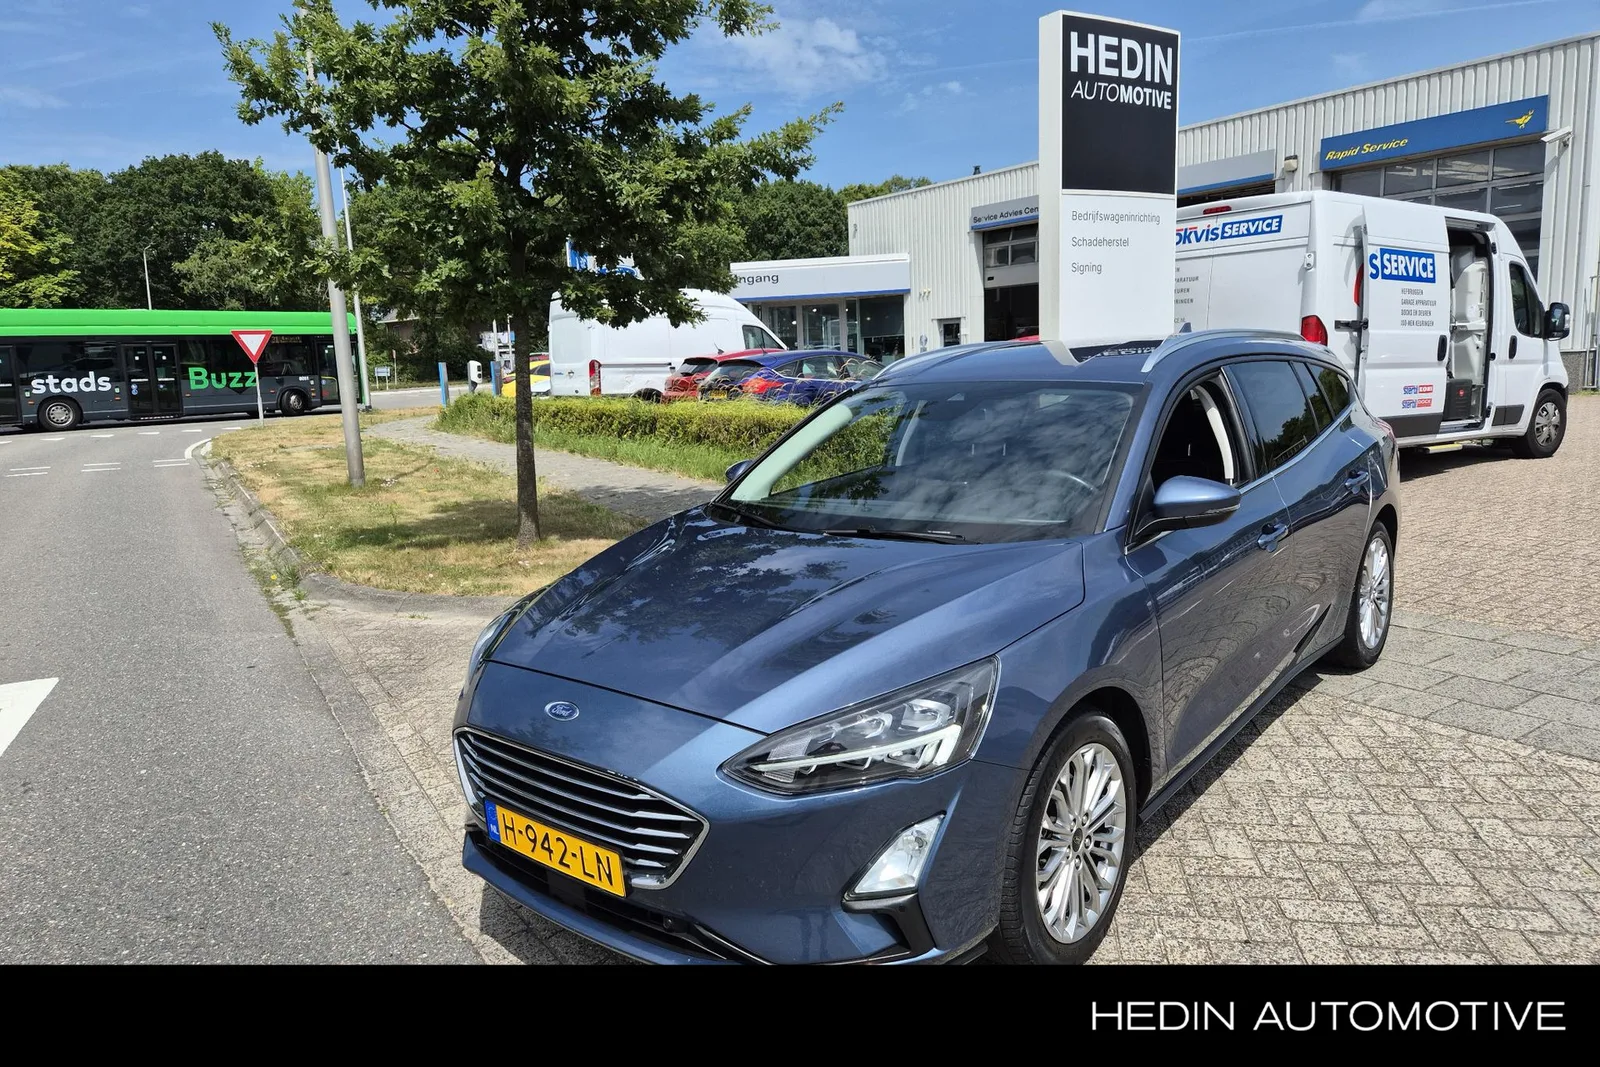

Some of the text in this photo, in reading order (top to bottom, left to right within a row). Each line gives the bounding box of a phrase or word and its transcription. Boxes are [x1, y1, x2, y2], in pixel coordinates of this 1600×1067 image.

[1070, 31, 1173, 86] HEDIN
[1070, 80, 1172, 110] AUTOMOTIVE
[1325, 137, 1408, 162] Rapid Service
[999, 209, 1023, 219] Advies
[1071, 210, 1161, 226] Bedrijfswageninrichting
[1222, 217, 1280, 238] SERVICE
[1071, 236, 1130, 248] Schadeherstel
[1071, 262, 1103, 275] Signing
[1383, 253, 1434, 279] SERVICE
[31, 367, 258, 395] stads Buzz
[551, 704, 573, 717] Ford
[490, 812, 614, 886] NL H-942-LN
